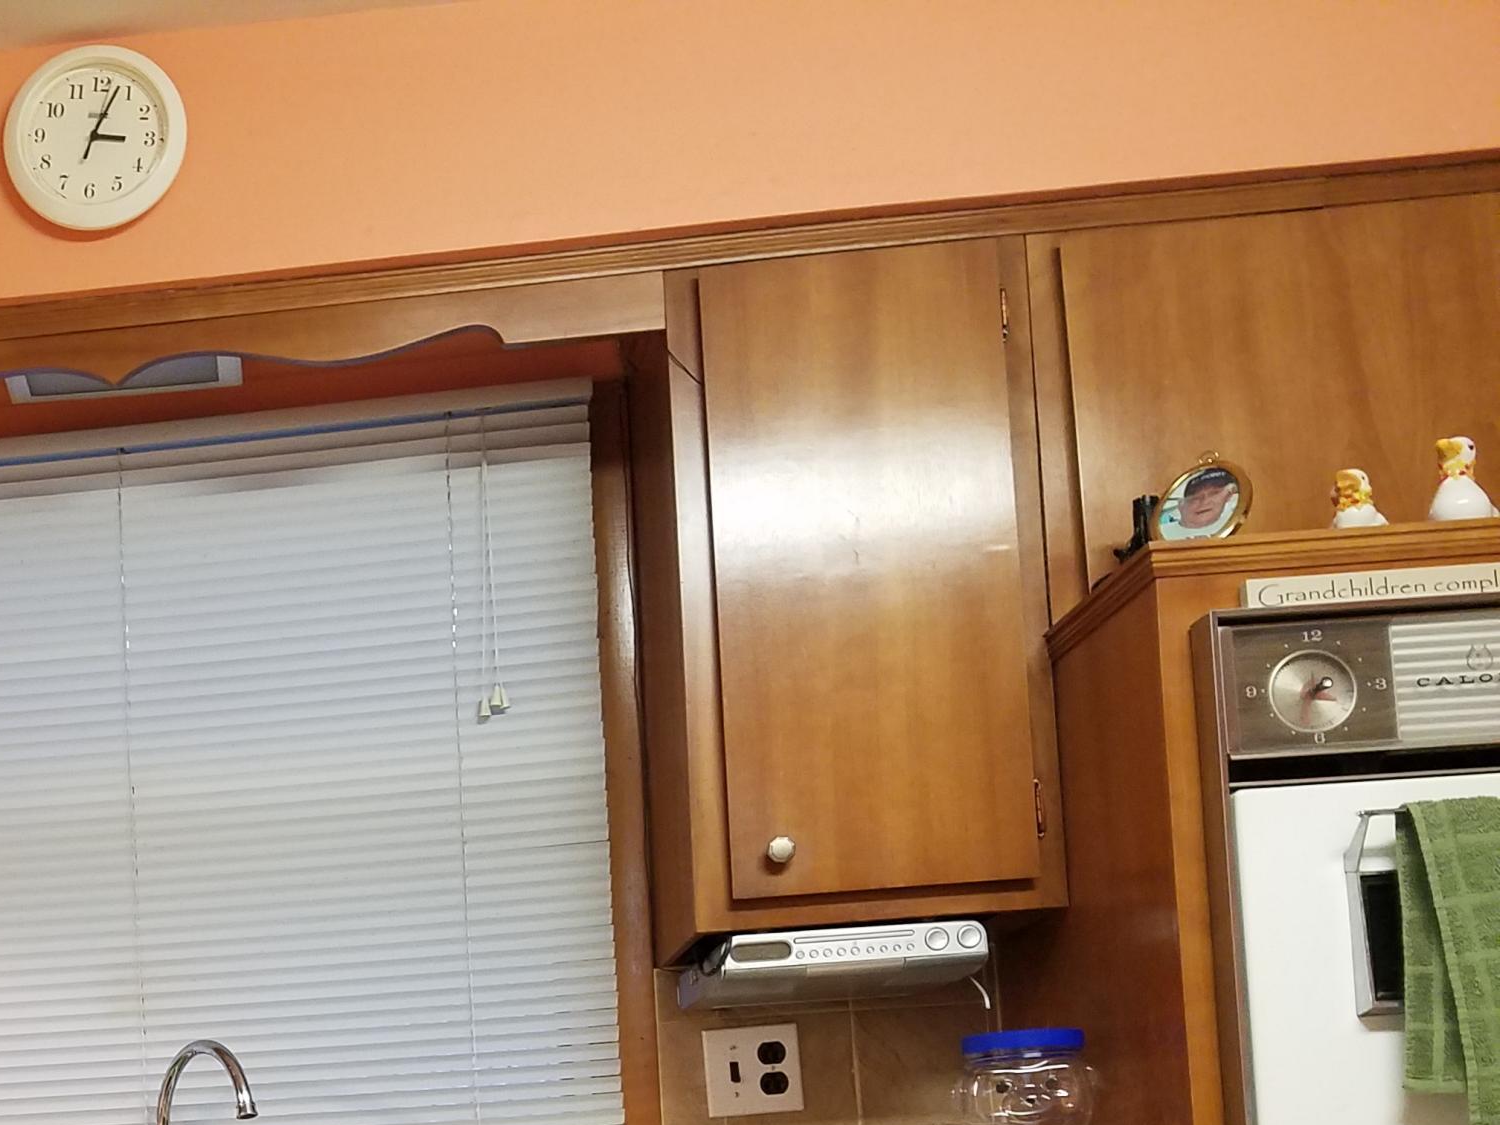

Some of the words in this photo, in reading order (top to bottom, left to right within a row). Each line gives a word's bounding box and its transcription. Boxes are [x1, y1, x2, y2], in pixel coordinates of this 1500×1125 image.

[69, 83, 84, 100] 11
[92, 76, 112, 93] 12
[125, 85, 132, 101] 1
[47, 102, 65, 118] 10
[139, 104, 150, 120] 2
[34, 127, 46, 143] 9
[143, 131, 156, 147] 3
[39, 154, 52, 170] 8
[132, 157, 144, 173] 4
[59, 174, 69, 190] 7
[111, 176, 123, 192] 5
[83, 183, 95, 199] 6
[1258, 576, 1427, 608] Grandchildren
[1301, 629, 1324, 643] 12
[1374, 677, 1388, 691] 3
[1416, 672, 1500, 688] CALO
[1245, 685, 1258, 698] 9
